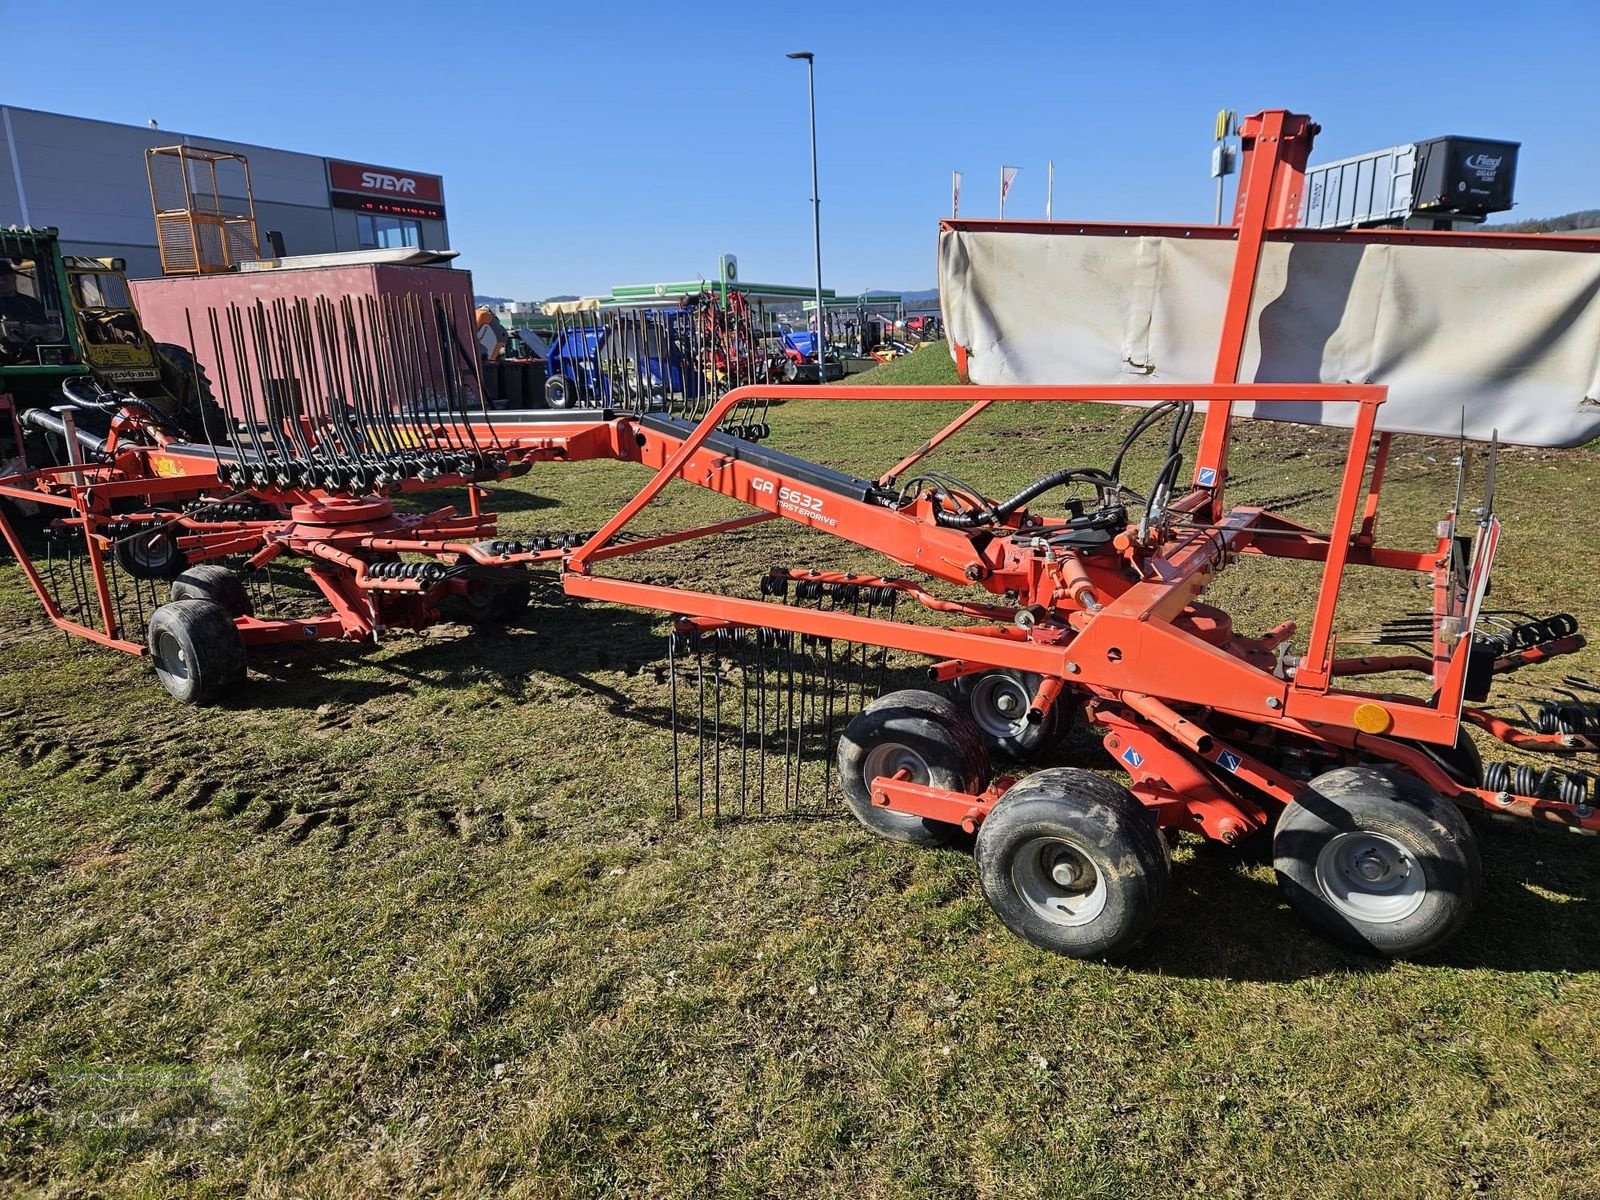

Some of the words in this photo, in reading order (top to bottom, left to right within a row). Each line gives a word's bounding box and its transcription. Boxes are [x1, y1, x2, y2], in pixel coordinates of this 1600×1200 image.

[1475, 154, 1503, 170] Fliegl
[361, 172, 416, 194] STEYR
[752, 477, 774, 494] GA
[778, 486, 824, 512] 6632
[776, 499, 837, 526] MASTERDRIVE
